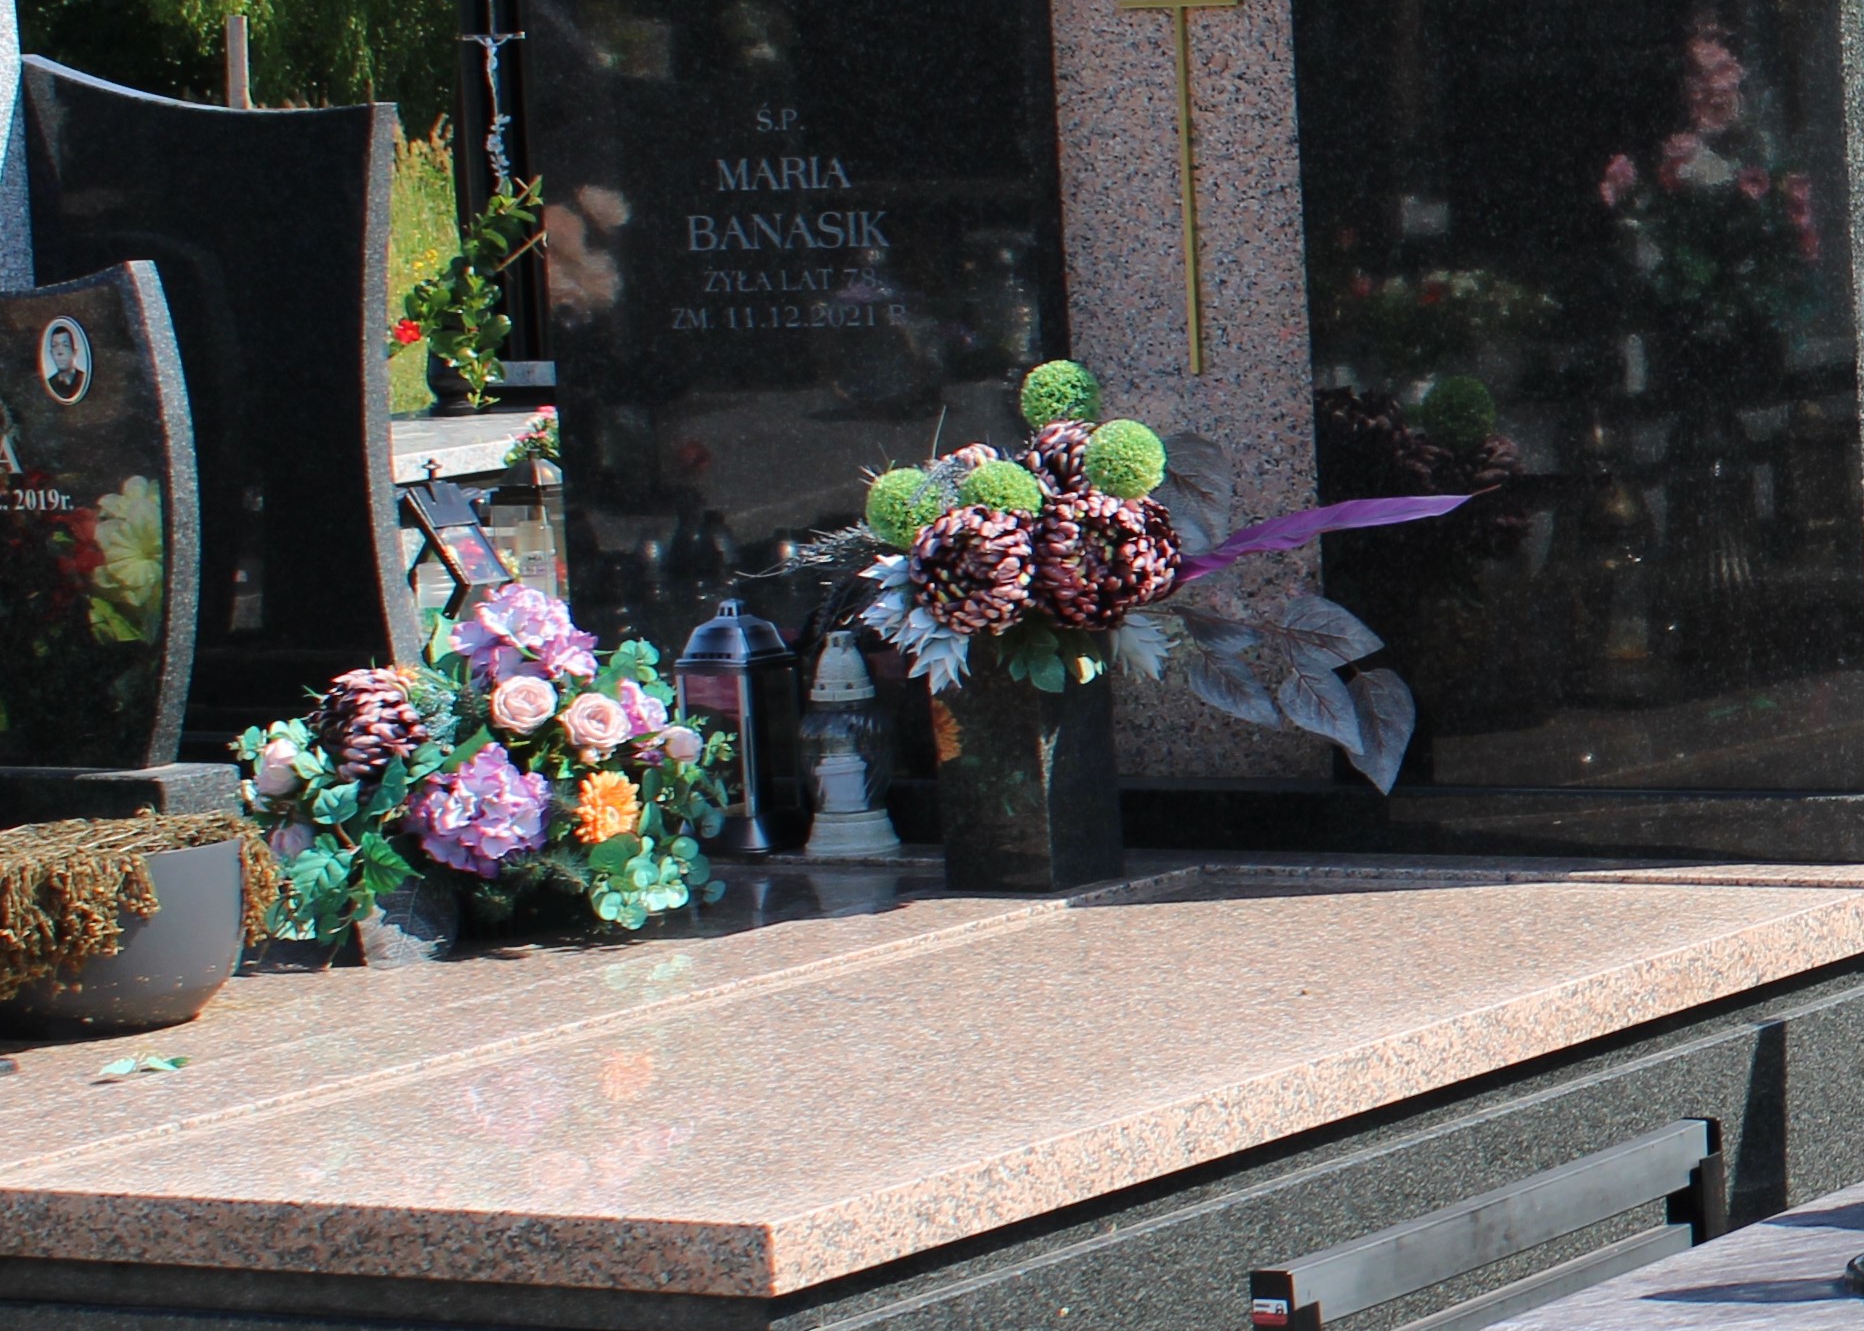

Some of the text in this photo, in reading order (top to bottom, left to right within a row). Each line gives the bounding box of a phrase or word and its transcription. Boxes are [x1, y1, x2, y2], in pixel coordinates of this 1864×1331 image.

[756, 102, 806, 132] Ś.P.
[716, 156, 852, 191] MARIA
[687, 211, 890, 251] BANASIK
[704, 266, 773, 293] ŻYŁA
[781, 268, 834, 291] LAT
[671, 307, 715, 330] ZM.
[727, 304, 876, 329] 11.12.2021
